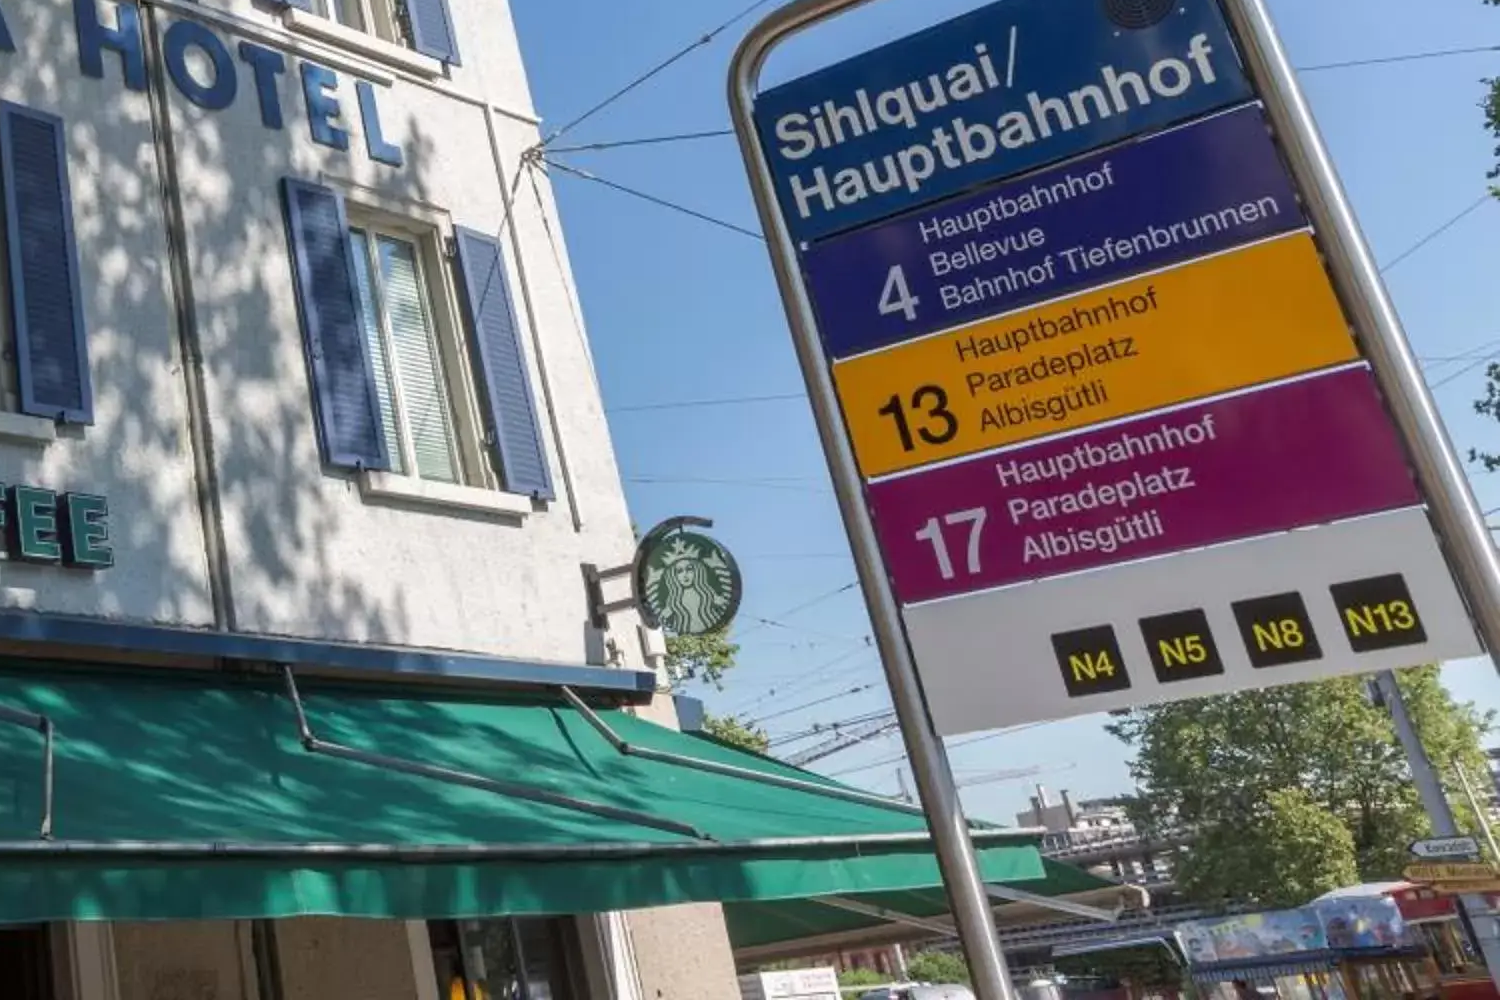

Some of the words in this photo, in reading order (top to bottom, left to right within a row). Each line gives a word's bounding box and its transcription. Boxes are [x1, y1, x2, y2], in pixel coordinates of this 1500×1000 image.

[774, 25, 1018, 160] Sihlquai/
[789, 33, 1218, 219] Hauptbahnhof
[918, 162, 1116, 244] Hauptbahnhof
[929, 224, 1047, 277] Bellevue
[940, 256, 1055, 311] Bahnhof
[1060, 194, 1281, 275] Tiefenbrunnen
[877, 263, 920, 322] 4
[956, 287, 1159, 362] Hauptbahnhof
[965, 335, 1140, 396] Paradeplatz
[878, 384, 959, 452] 13
[979, 379, 1109, 433] Albisgütli
[995, 414, 1218, 488] Hauptbahnhof
[1007, 466, 1196, 526] Paradeplatz
[915, 506, 988, 580] 17
[1022, 509, 1165, 563] Albisgütli
[1069, 651, 1115, 682] N4
[1158, 635, 1207, 668] N5
[1253, 619, 1304, 652] N8
[1344, 600, 1415, 638] N13
